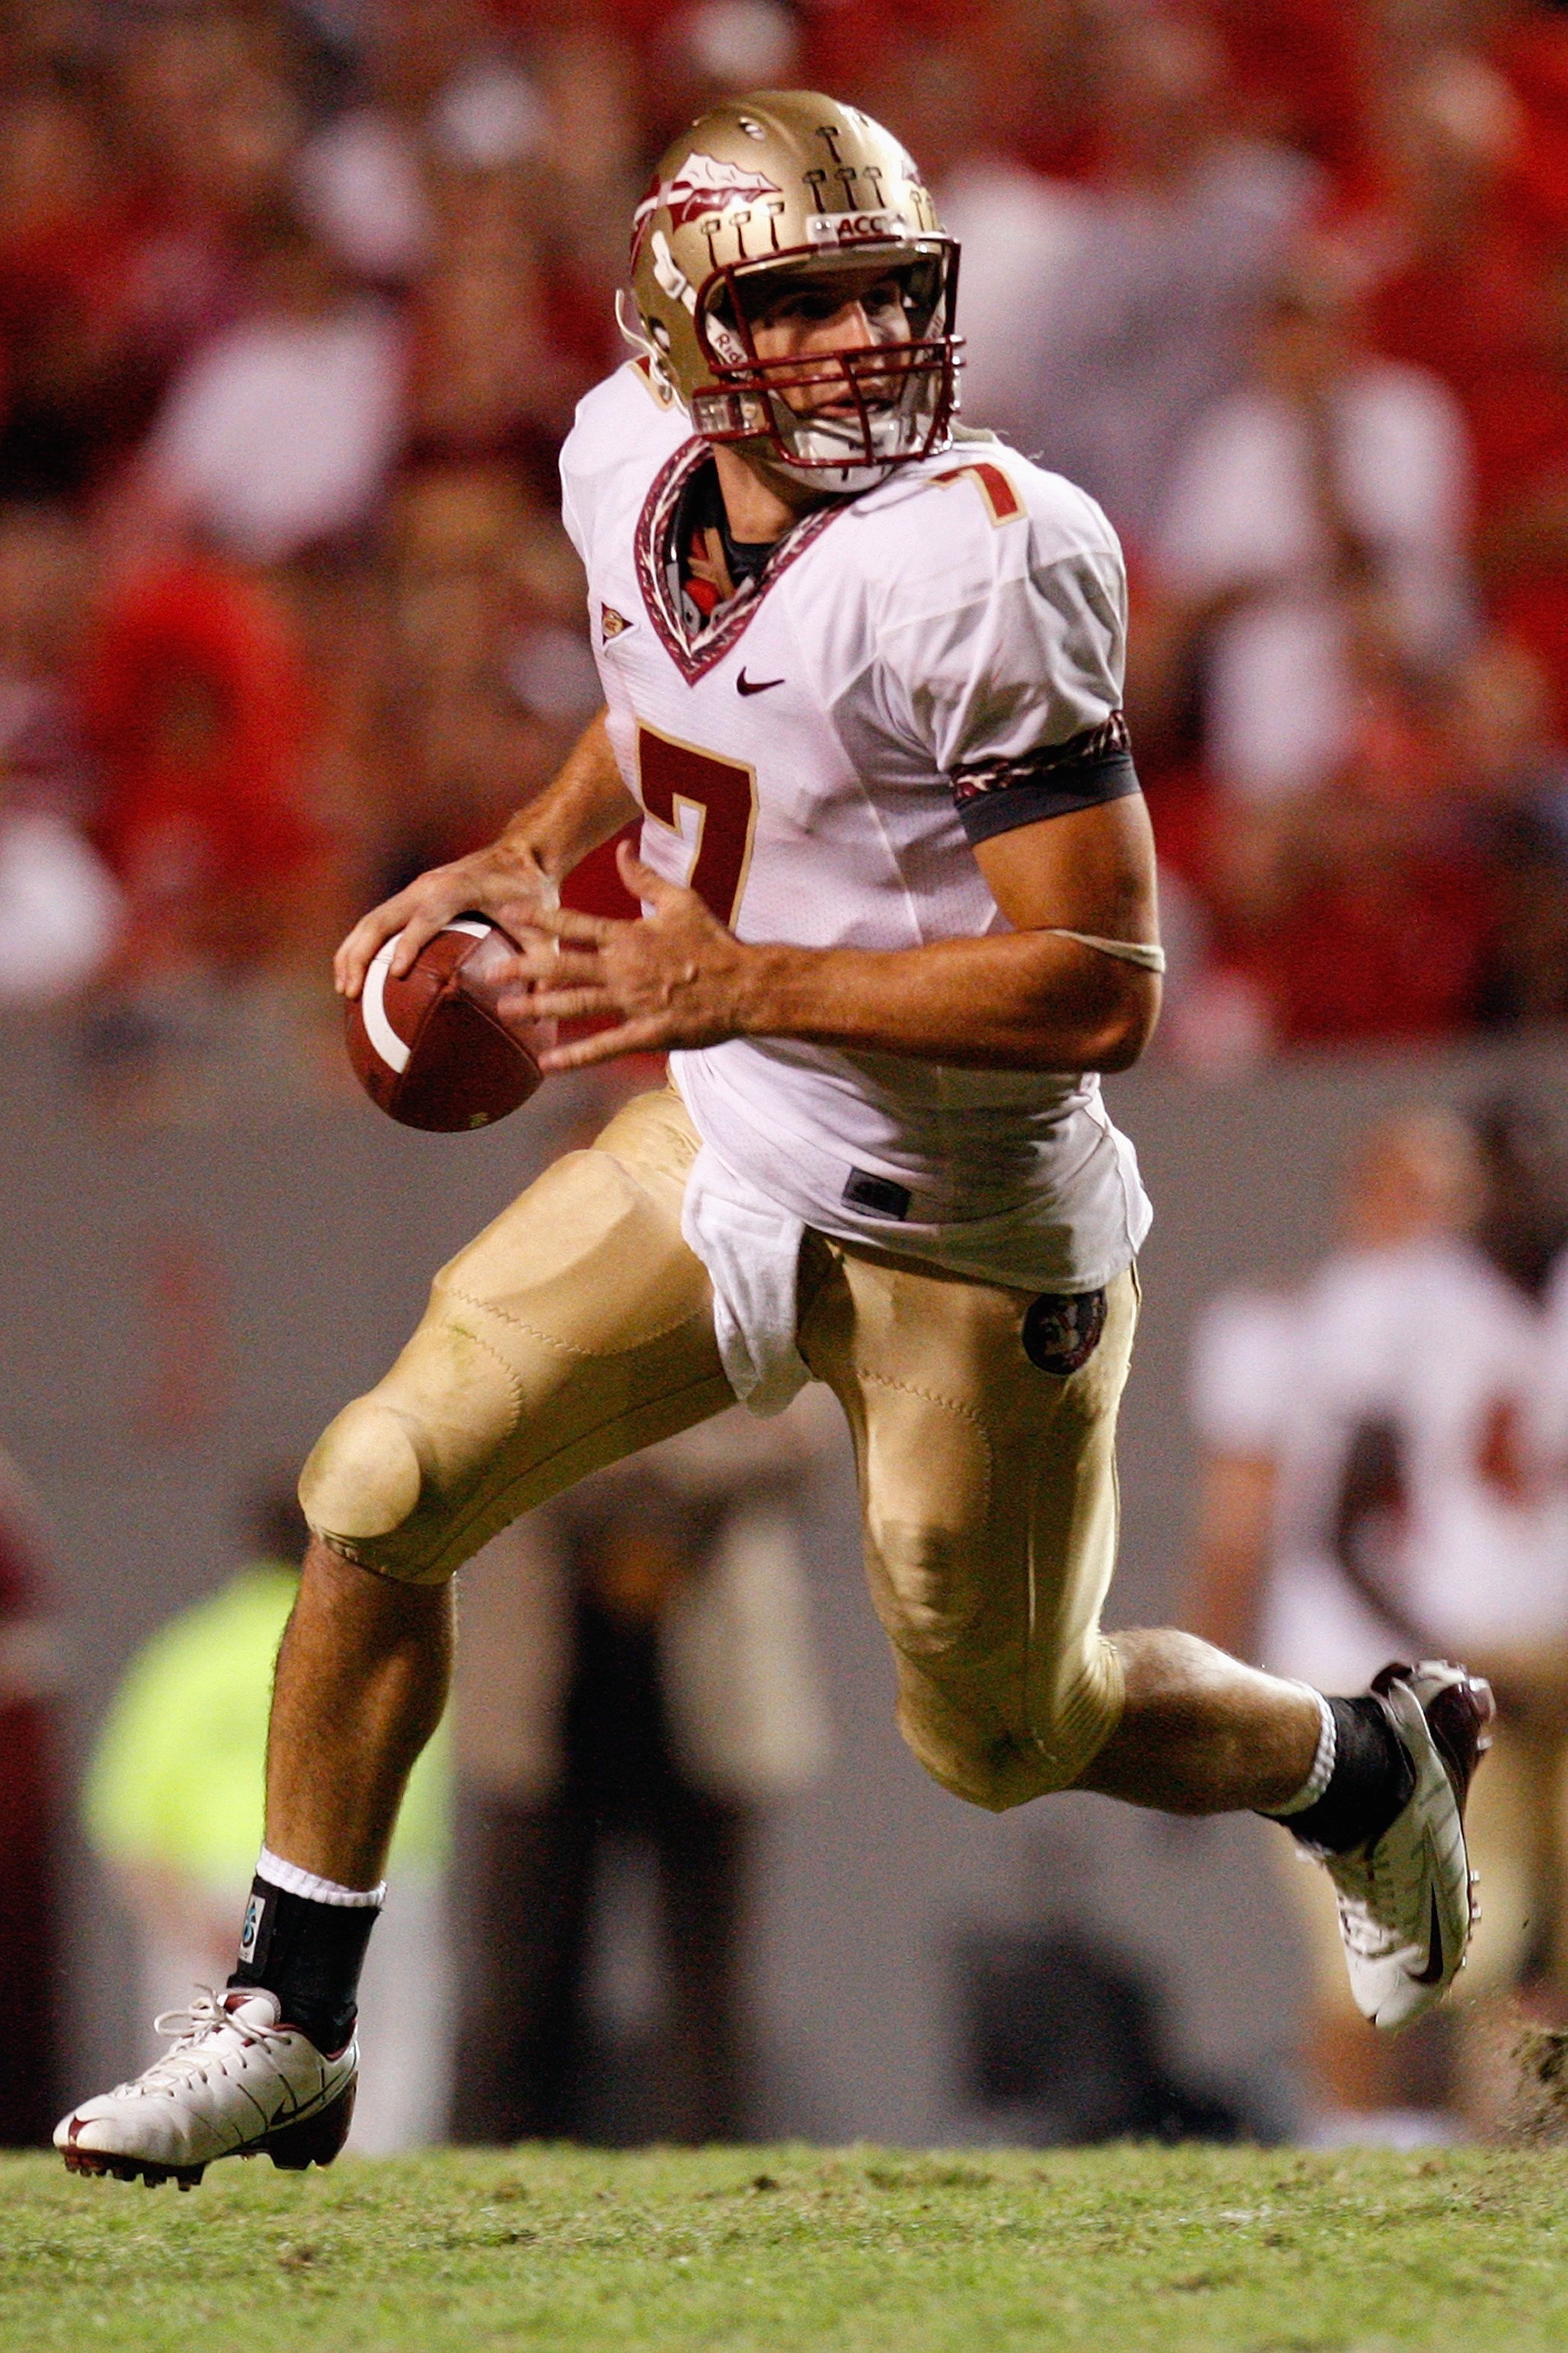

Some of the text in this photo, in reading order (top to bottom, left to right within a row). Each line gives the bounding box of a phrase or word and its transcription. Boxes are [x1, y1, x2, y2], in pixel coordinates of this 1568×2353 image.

[837, 215, 886, 236] ACC
[920, 462, 1028, 528] 7
[636, 717, 760, 934] 7
